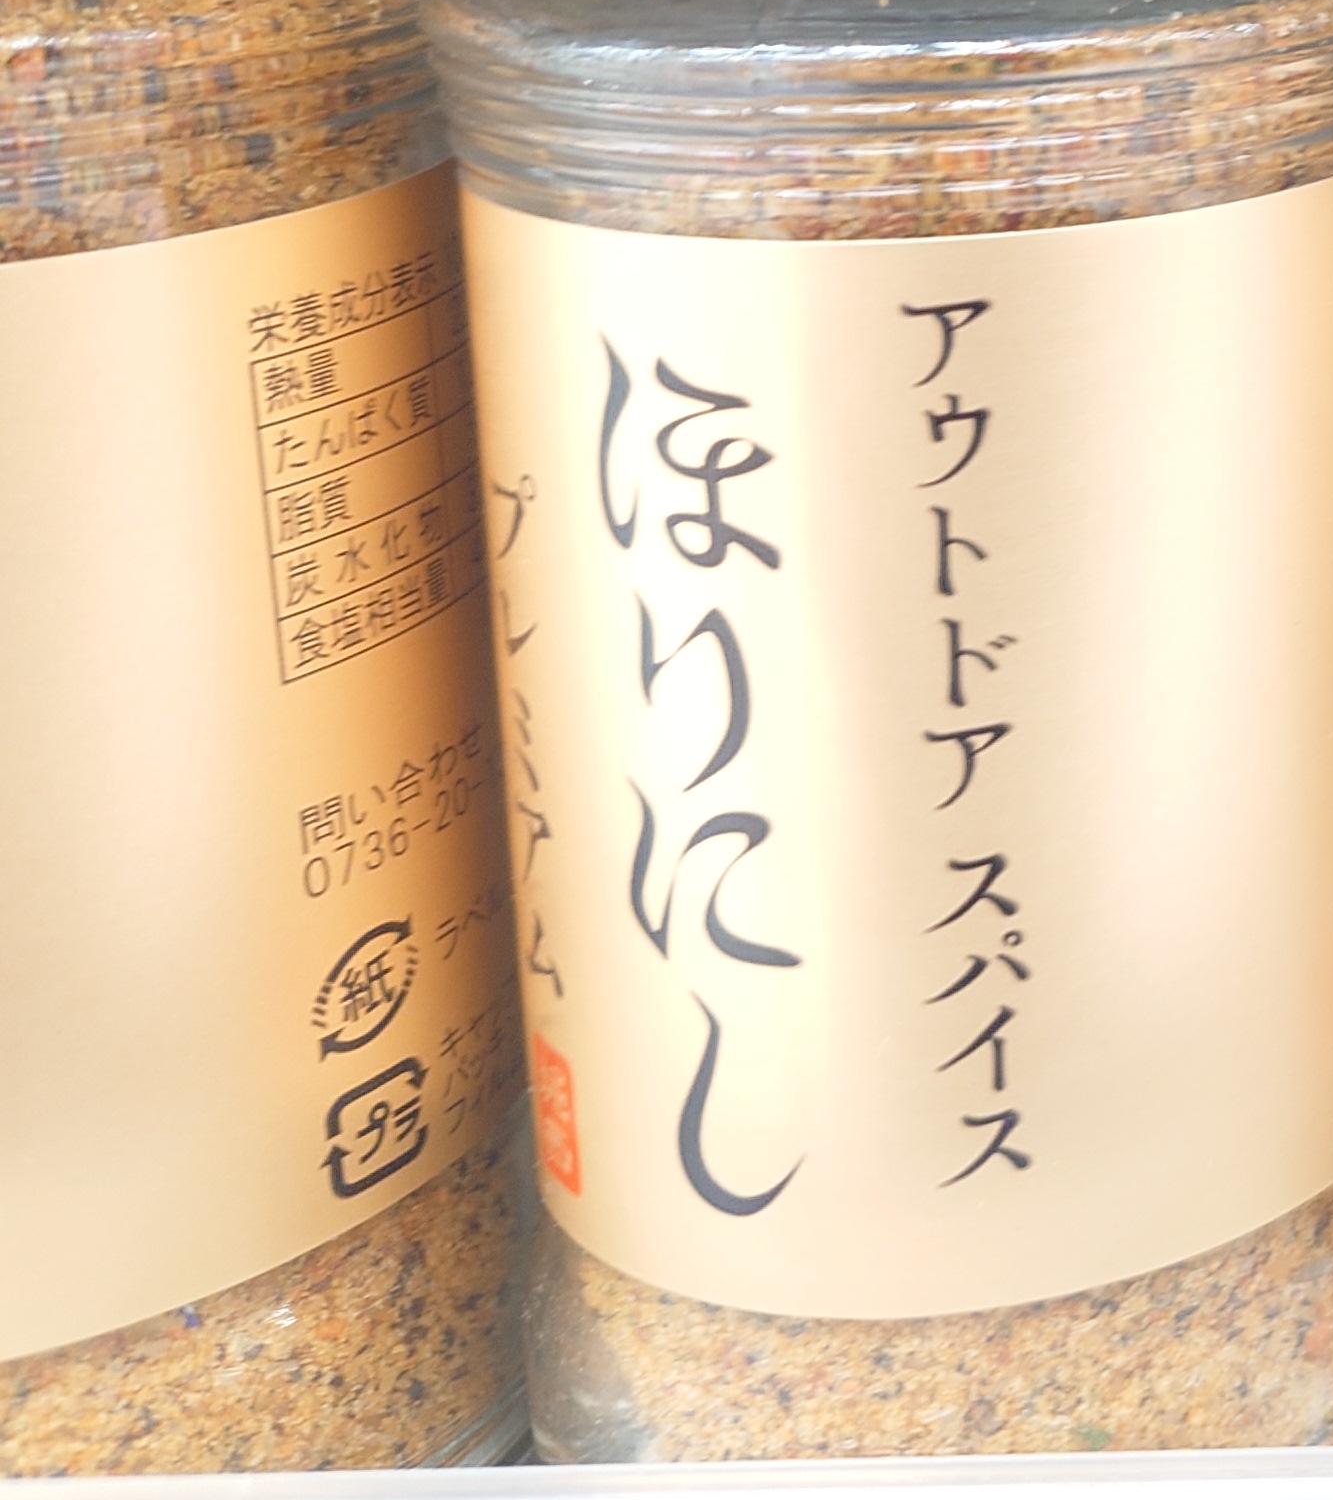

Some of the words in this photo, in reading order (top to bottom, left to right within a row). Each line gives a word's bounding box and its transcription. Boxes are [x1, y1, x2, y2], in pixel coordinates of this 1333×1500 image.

[262, 347, 342, 415] 熱量
[272, 376, 433, 475] たんぱく質
[277, 474, 354, 544] 脂質
[899, 297, 1018, 812] アウトドア
[490, 473, 565, 1000] プレミアム
[597, 329, 806, 1219] ほりにし
[339, 949, 397, 1023] 紙
[923, 852, 1034, 1190] スパイス
[352, 1099, 422, 1166] プラ
